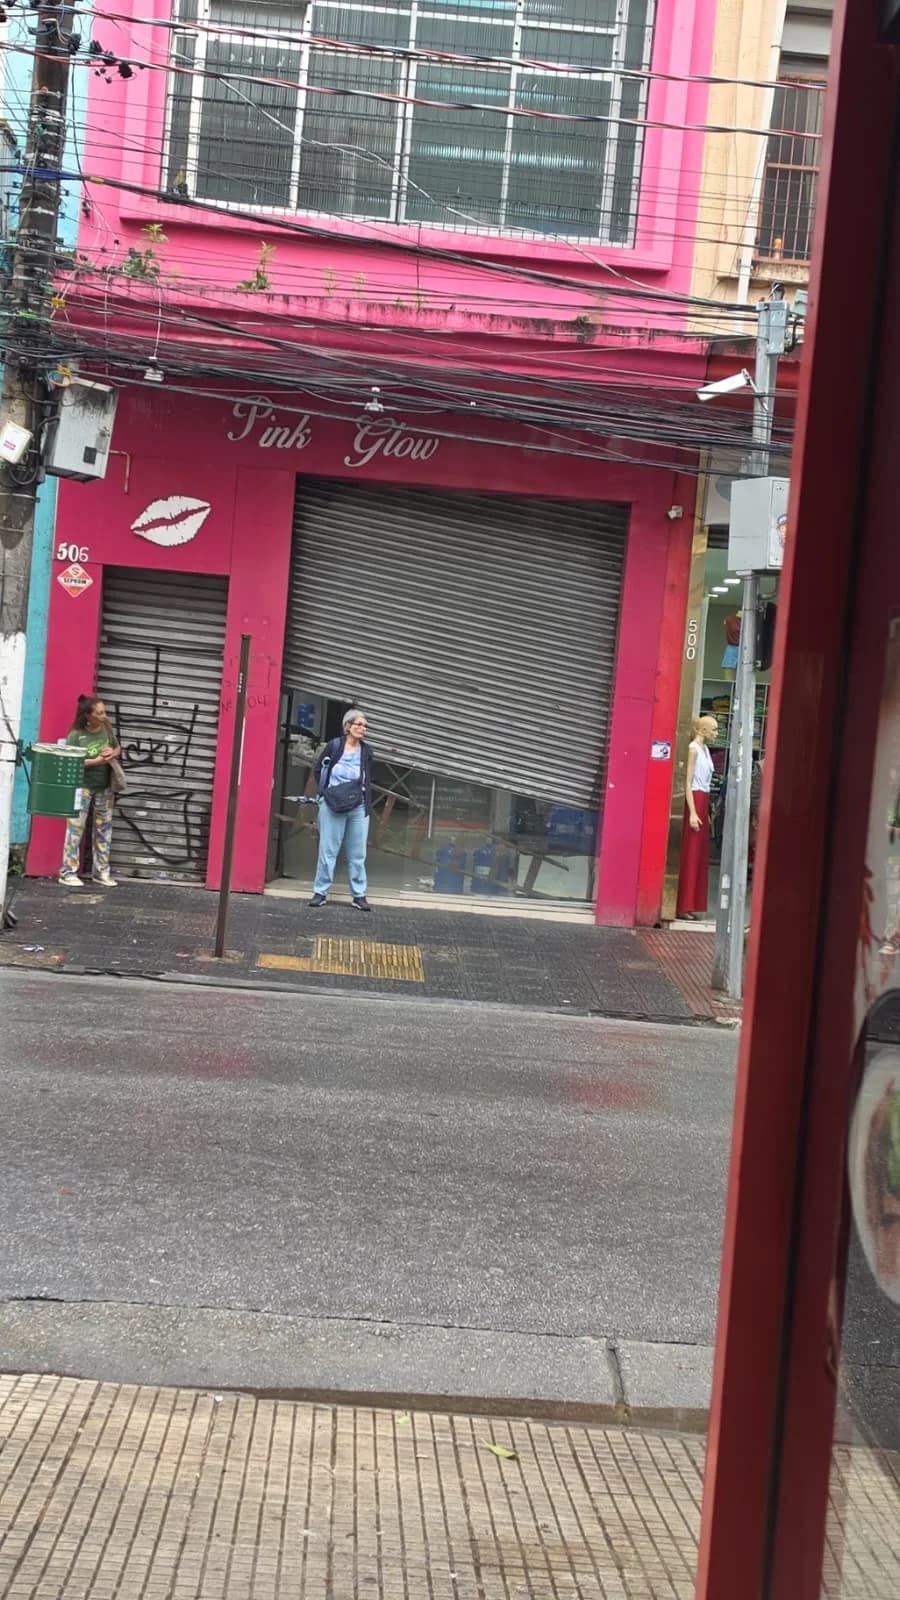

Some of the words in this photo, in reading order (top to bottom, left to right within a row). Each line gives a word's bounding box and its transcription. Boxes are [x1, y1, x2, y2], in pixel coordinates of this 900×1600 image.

[227, 395, 311, 448] Pink
[344, 415, 439, 467] Glow
[57, 542, 89, 562] 506
[686, 620, 697, 660] 500
